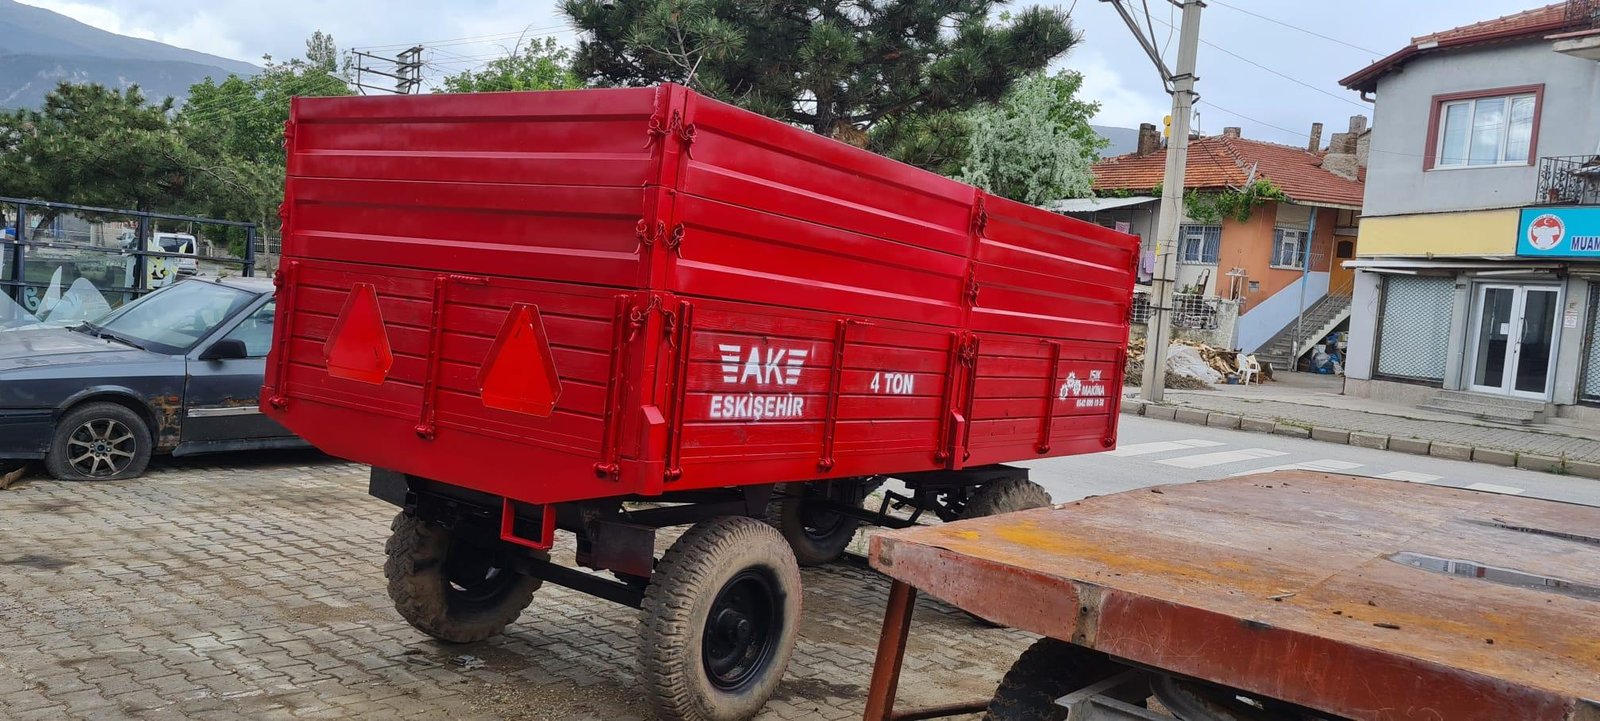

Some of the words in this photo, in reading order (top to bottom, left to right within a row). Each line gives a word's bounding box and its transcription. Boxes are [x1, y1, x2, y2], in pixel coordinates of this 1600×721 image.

[870, 372, 880, 393] 4
[885, 373, 914, 394] TON
[1081, 383, 1105, 396] MAKİNA
[709, 392, 804, 420] ESKİŞEHİR
